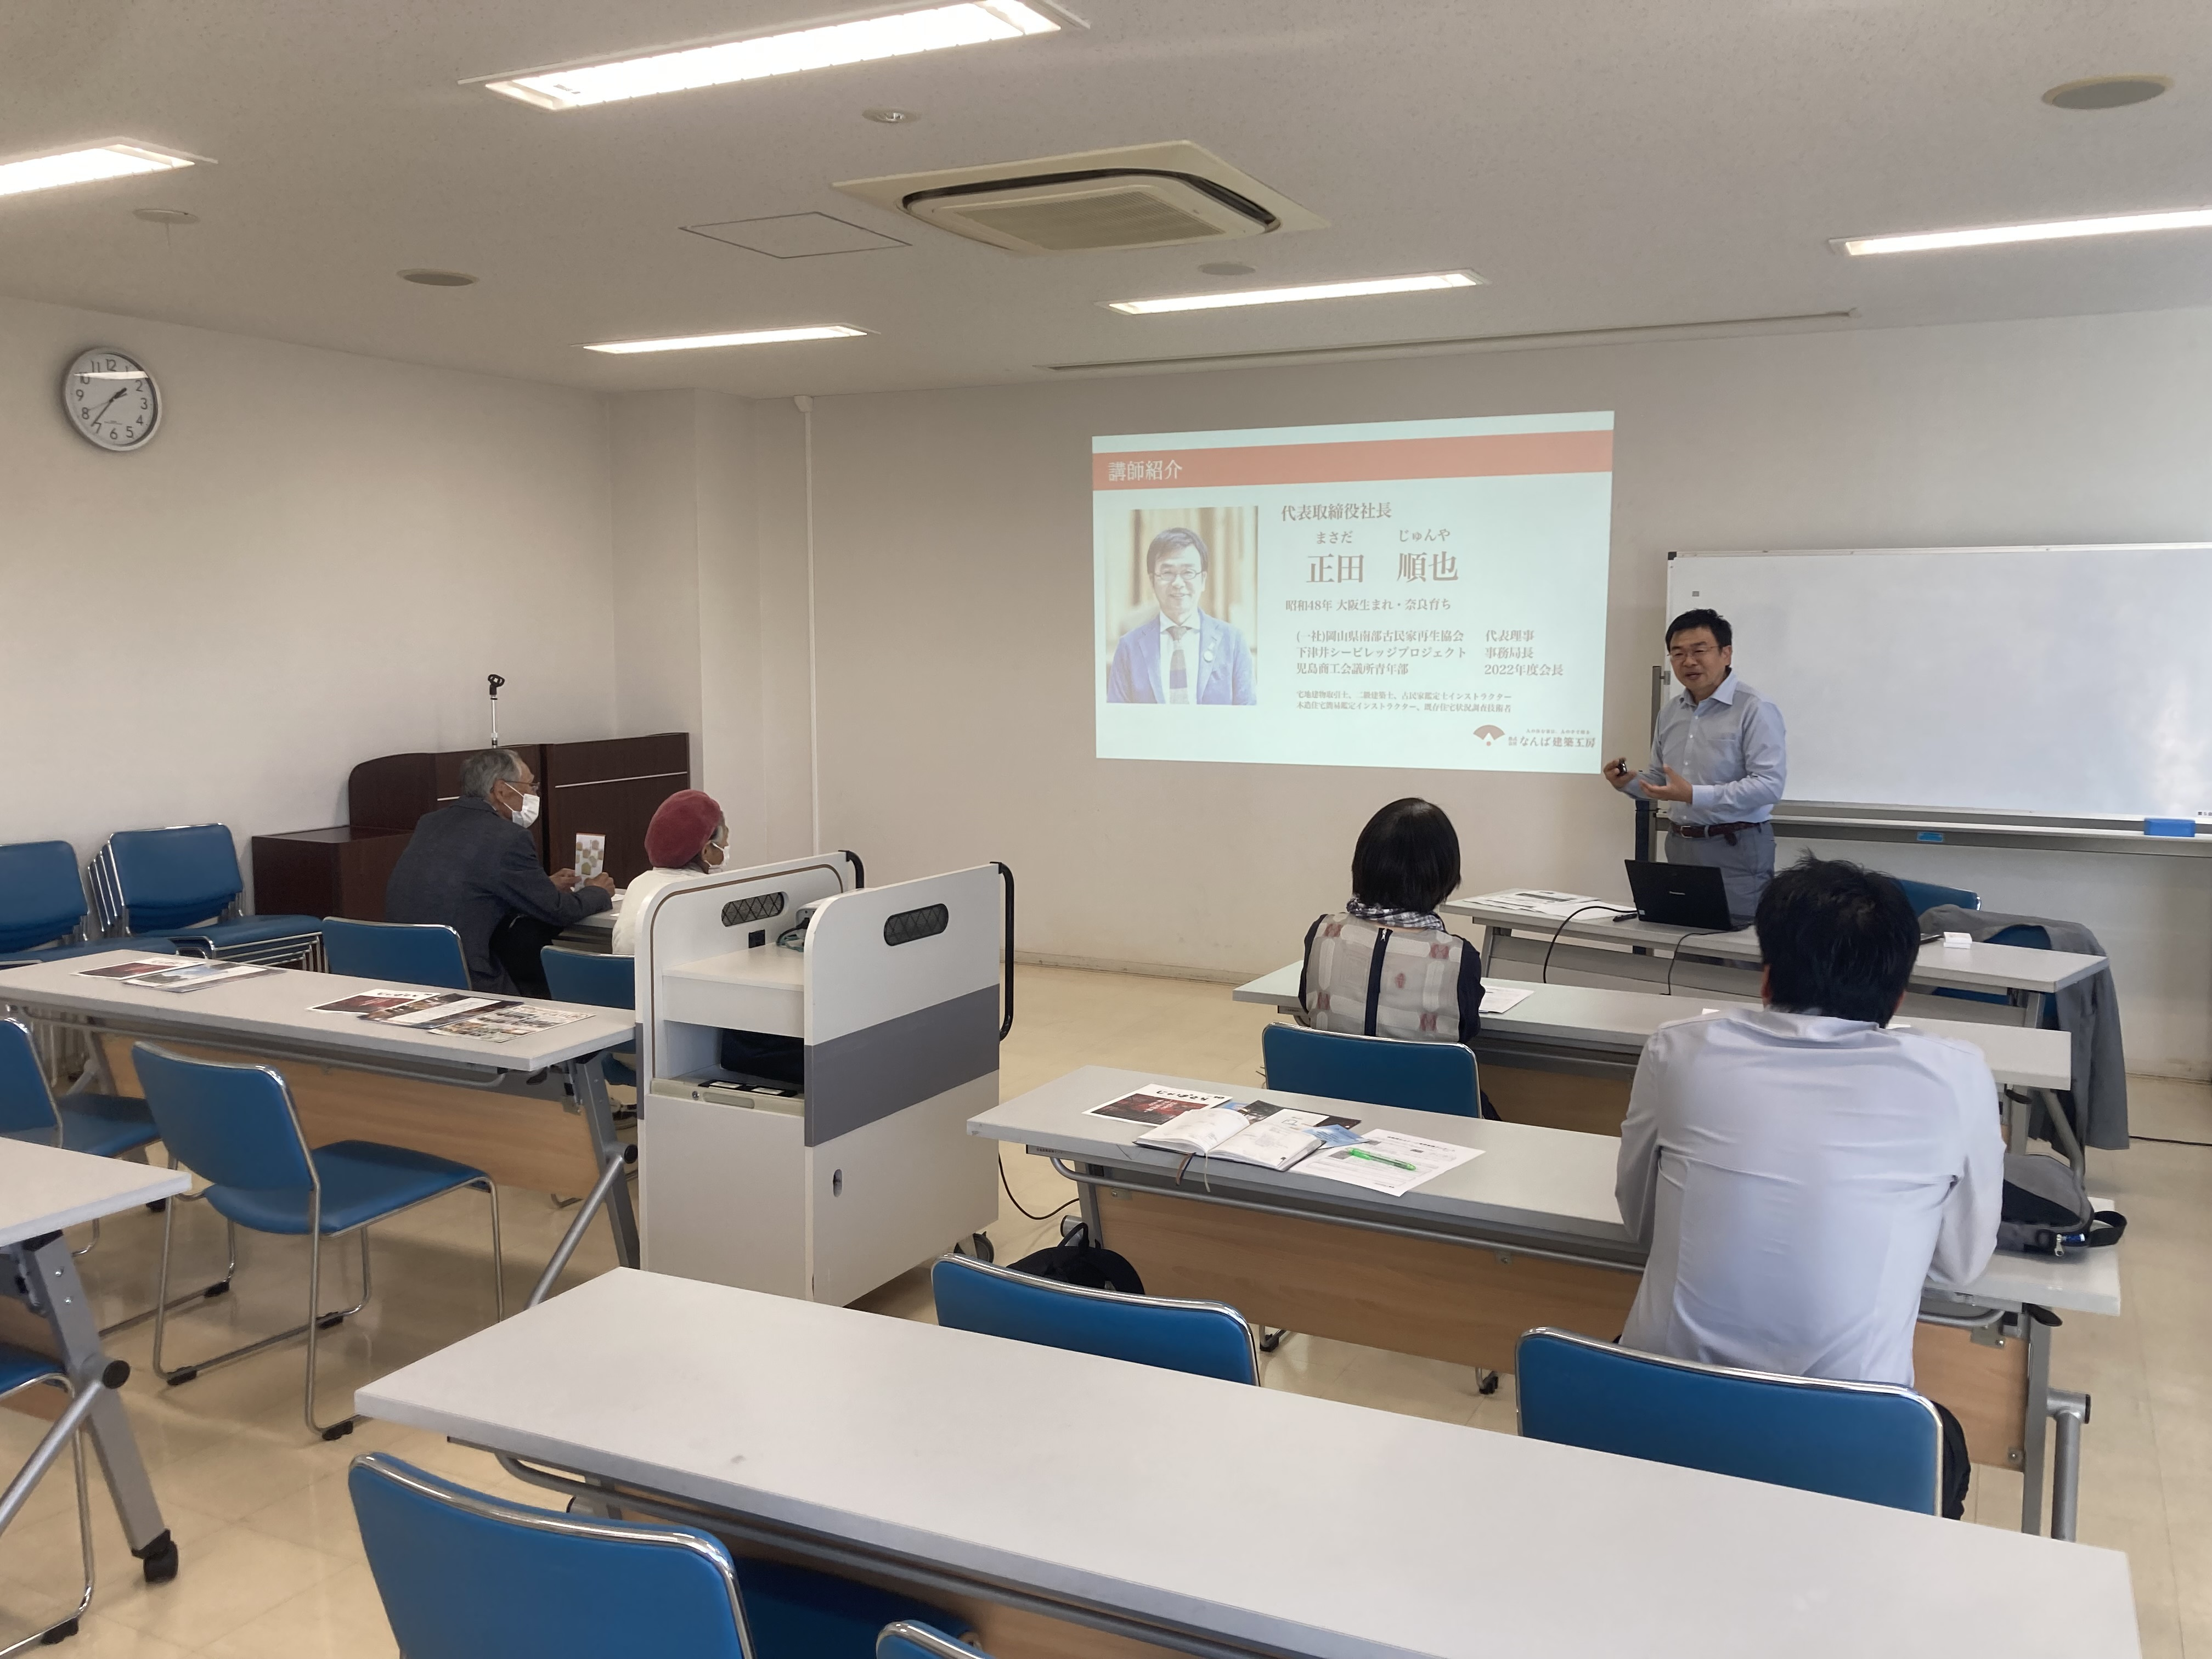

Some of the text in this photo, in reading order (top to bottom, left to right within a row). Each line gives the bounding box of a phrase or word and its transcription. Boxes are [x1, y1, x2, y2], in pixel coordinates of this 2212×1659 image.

[91, 360, 100, 373] 11
[105, 359, 116, 371] 12
[136, 380, 143, 392] 2
[76, 390, 84, 401] 9
[140, 398, 148, 409] 3
[82, 407, 89, 420] 8
[136, 415, 143, 425] 4
[94, 421, 101, 433] 7
[126, 426, 133, 438] 5
[110, 428, 117, 439] 6
[1108, 459, 1183, 482] 講師紹介
[1282, 502, 1392, 521] 代表取締役社長
[1317, 529, 1450, 544] まさだ じゅんや
[1306, 551, 1458, 583] 正田 順也
[1285, 598, 1451, 611] 昭和48年 大阪生まれ・奈良育ち
[1486, 630, 1534, 642] 代表理事
[1296, 646, 1533, 658] 下津井シービレッジプロジェクト 事務局長
[1296, 663, 1563, 676] 児島商工会議所青年部 2022年度会長
[1520, 736, 1595, 748] なんば建築工房
